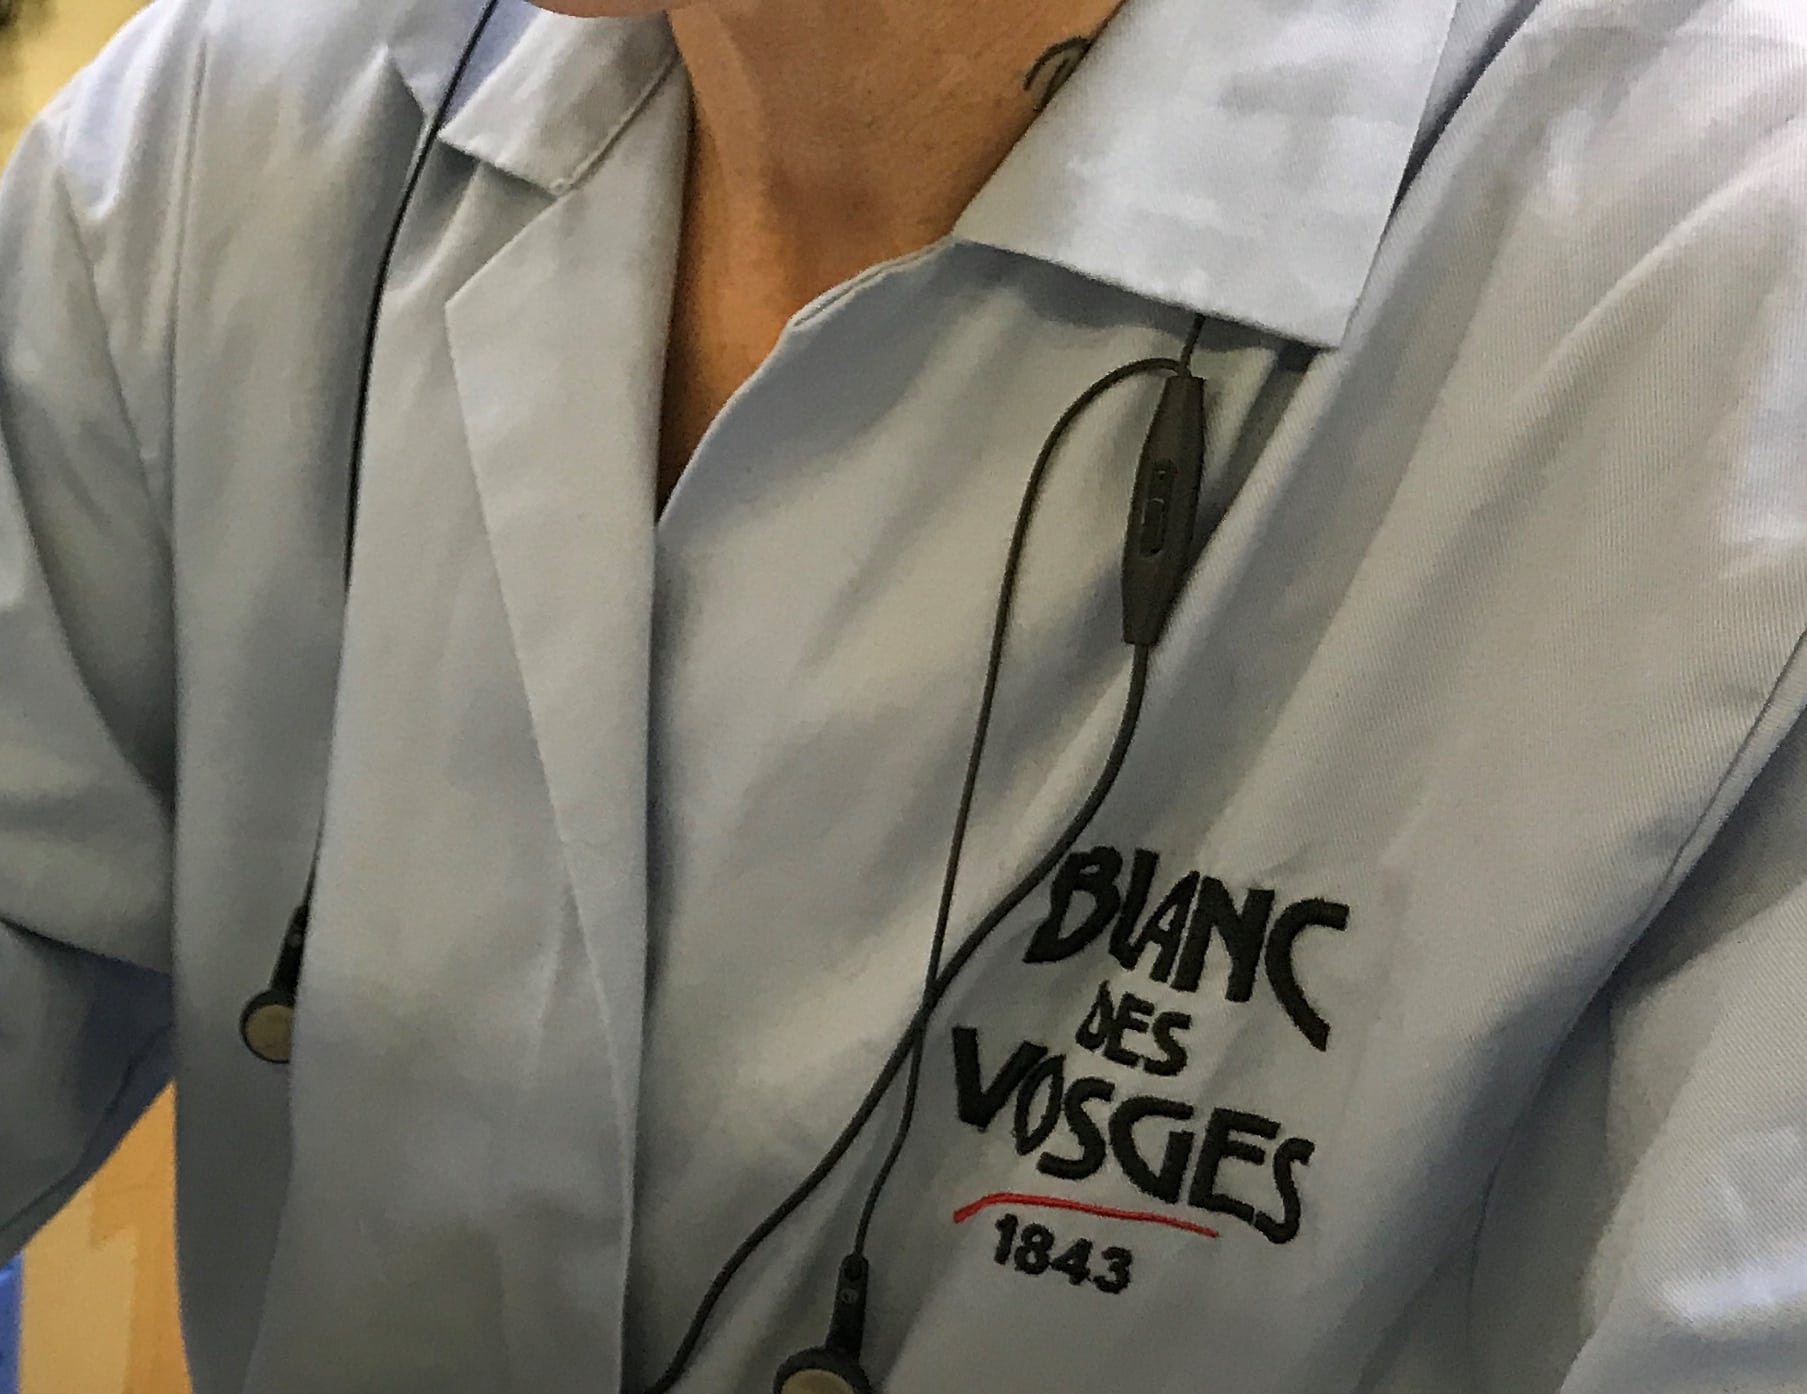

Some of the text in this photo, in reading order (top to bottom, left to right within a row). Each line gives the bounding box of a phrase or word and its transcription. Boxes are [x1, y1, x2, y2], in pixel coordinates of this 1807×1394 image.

[1022, 845, 1350, 1052] BLANC
[1075, 980, 1192, 1077] DES
[952, 1025, 1315, 1245] VOSGES
[994, 1213, 1133, 1295] 1843
